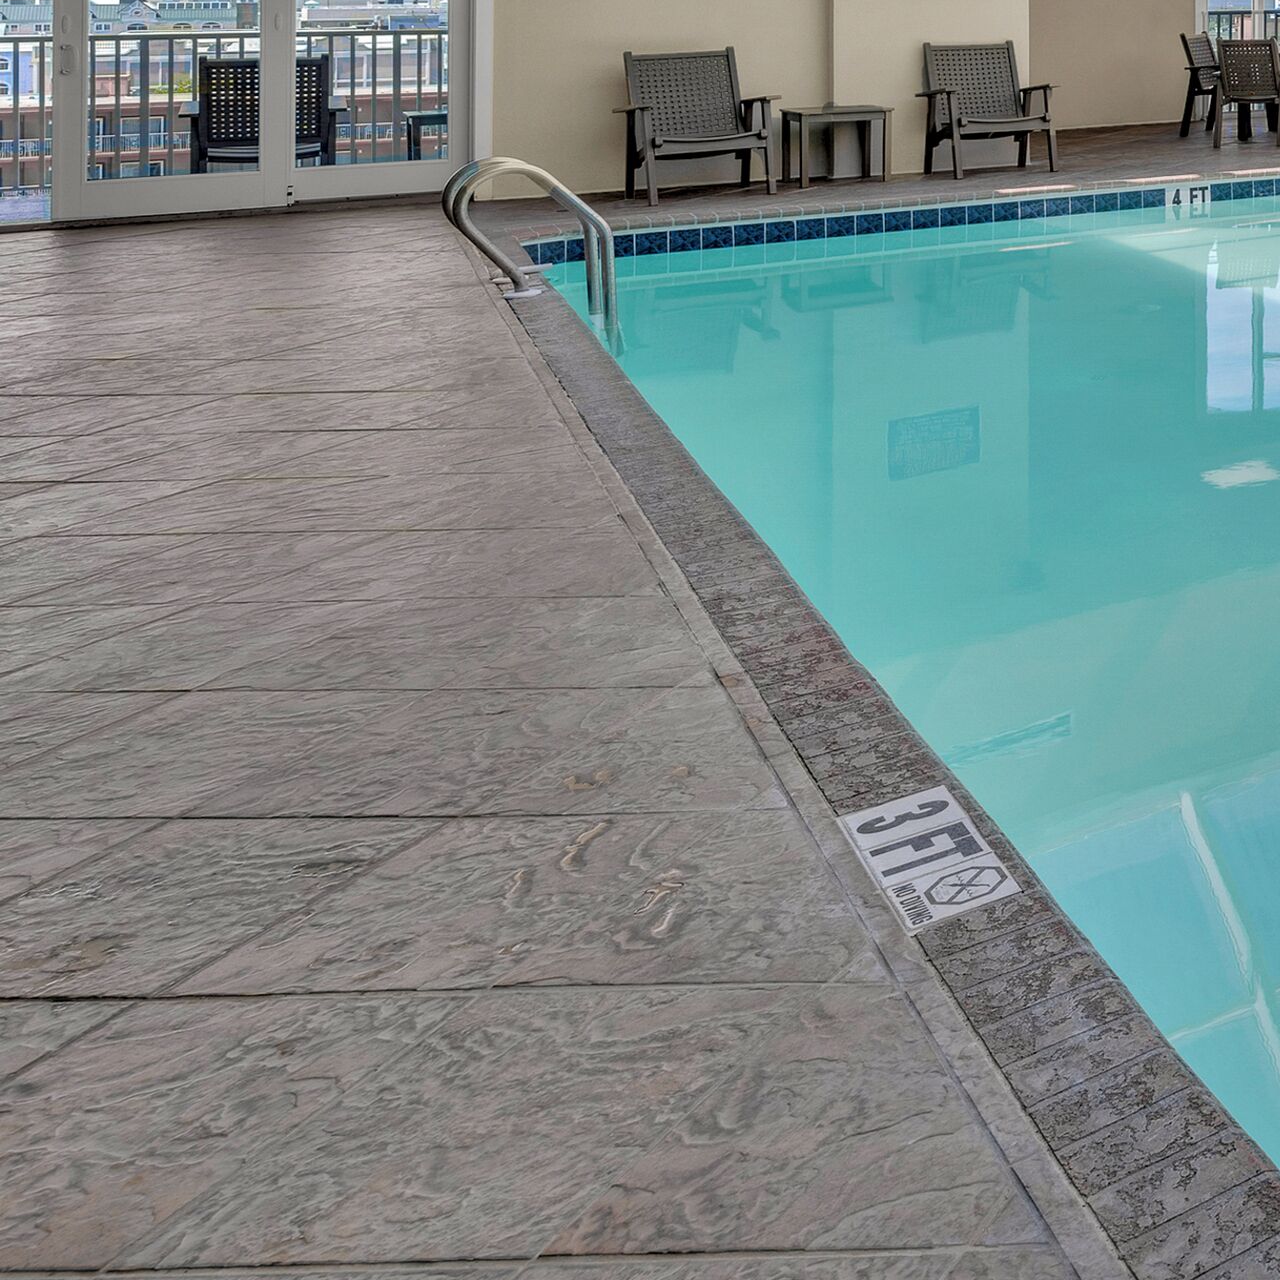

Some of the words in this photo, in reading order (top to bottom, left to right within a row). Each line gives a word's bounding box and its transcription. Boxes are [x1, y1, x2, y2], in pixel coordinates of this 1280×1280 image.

[1171, 188, 1182, 206] 4
[1189, 186, 1209, 204] FT
[856, 799, 950, 834] 3
[868, 821, 984, 878] FT
[892, 882, 917, 897] NO
[899, 895, 933, 926] DIVING
